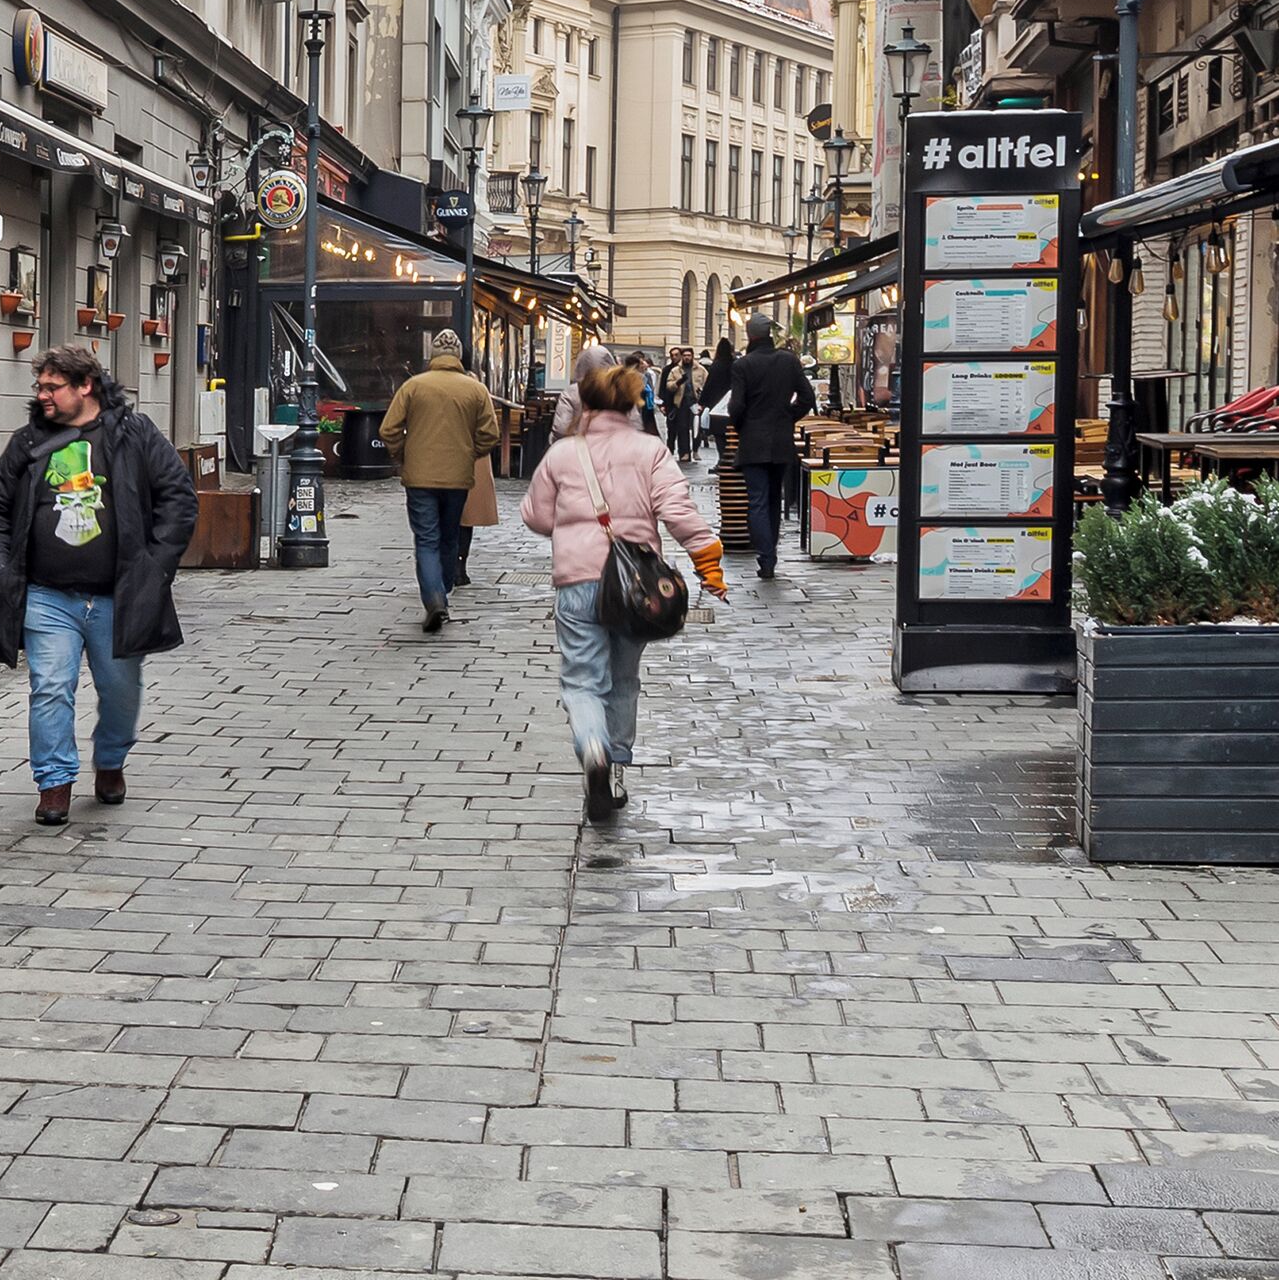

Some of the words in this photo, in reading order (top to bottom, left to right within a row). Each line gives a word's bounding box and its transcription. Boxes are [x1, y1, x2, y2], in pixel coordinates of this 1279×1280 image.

[436, 206, 470, 217] GUINNES
[297, 488, 313, 498] BNE
[297, 500, 314, 509] BNE
